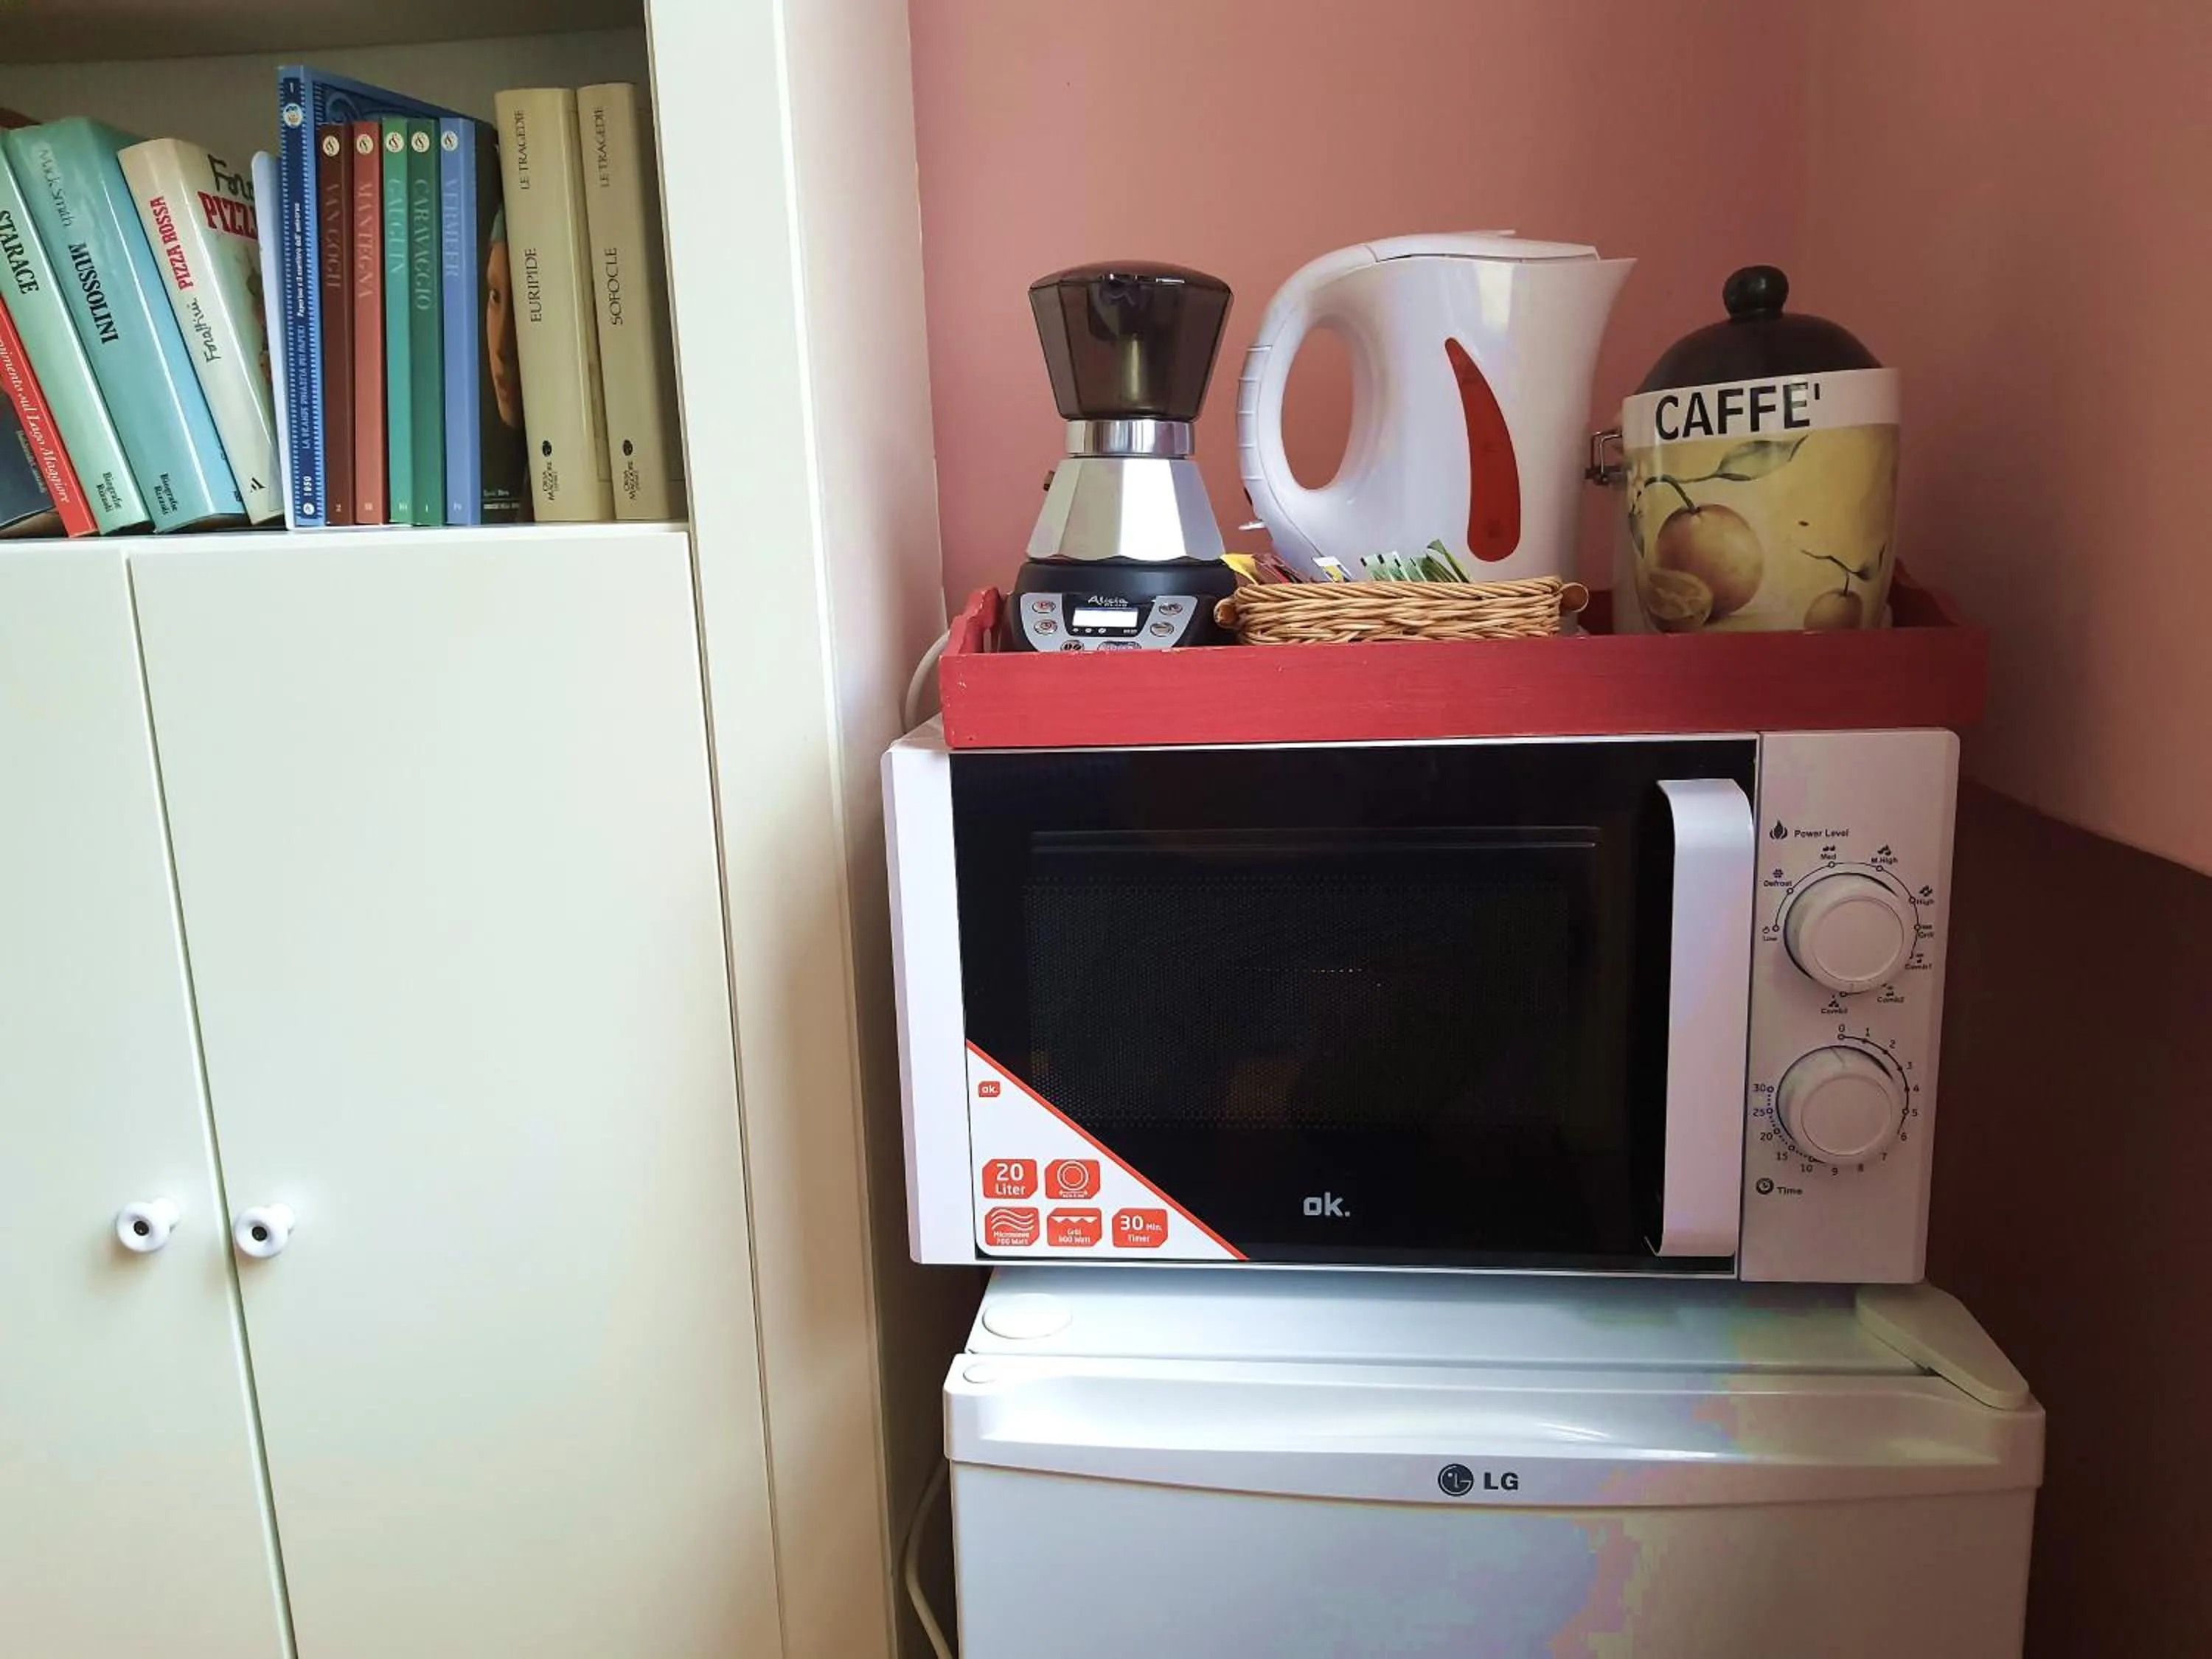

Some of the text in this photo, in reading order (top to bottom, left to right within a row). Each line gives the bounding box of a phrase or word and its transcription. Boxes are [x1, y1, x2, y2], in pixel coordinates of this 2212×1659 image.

[514, 110, 529, 171] TRAGEDIE
[594, 108, 608, 172] TRAGEDIE
[198, 191, 258, 240] PIZZ
[388, 178, 405, 274] GAUGUIN
[445, 178, 459, 276] VERMEER
[325, 184, 341, 287] VAN GOGH
[358, 183, 373, 298] MANTEGNA
[150, 196, 194, 291] PIZZA ROSSA
[414, 179, 431, 310] CARAVAGGIO
[0, 210, 39, 294] STARACE
[524, 247, 543, 322] EURIPIDE
[604, 247, 623, 325] SOFOCLE
[69, 243, 119, 344] MUSSOLINI
[1655, 381, 1820, 440] CAFFE'
[39, 447, 70, 503] Maggiore
[1088, 595, 1128, 606] Alicia
[1794, 829, 1849, 838] Power Level
[1838, 1024, 1845, 1032] 0
[1865, 1028, 1870, 1037] 1
[1889, 1040, 1896, 1048] 2
[1753, 1084, 1766, 1092] 30
[1753, 1108, 1765, 1116] 25
[1912, 1108, 1918, 1116] 5
[1760, 1133, 1773, 1141] 20
[1901, 1133, 1907, 1141] 6
[1776, 1152, 1788, 1161] 15
[1881, 1152, 1887, 1161] 7
[996, 1163, 1023, 1180] 20
[1801, 1164, 1812, 1172] 10
[1832, 1167, 1838, 1176] 9
[1857, 1164, 1864, 1172] 8
[995, 1183, 1026, 1195] Liter
[1777, 1186, 1802, 1195] Time
[1303, 1192, 1351, 1217] ok.
[1120, 1215, 1144, 1231] 30
[1074, 1235, 1091, 1243] Watt
[1127, 1234, 1150, 1242] Timer
[1484, 1472, 1519, 1491] LG
